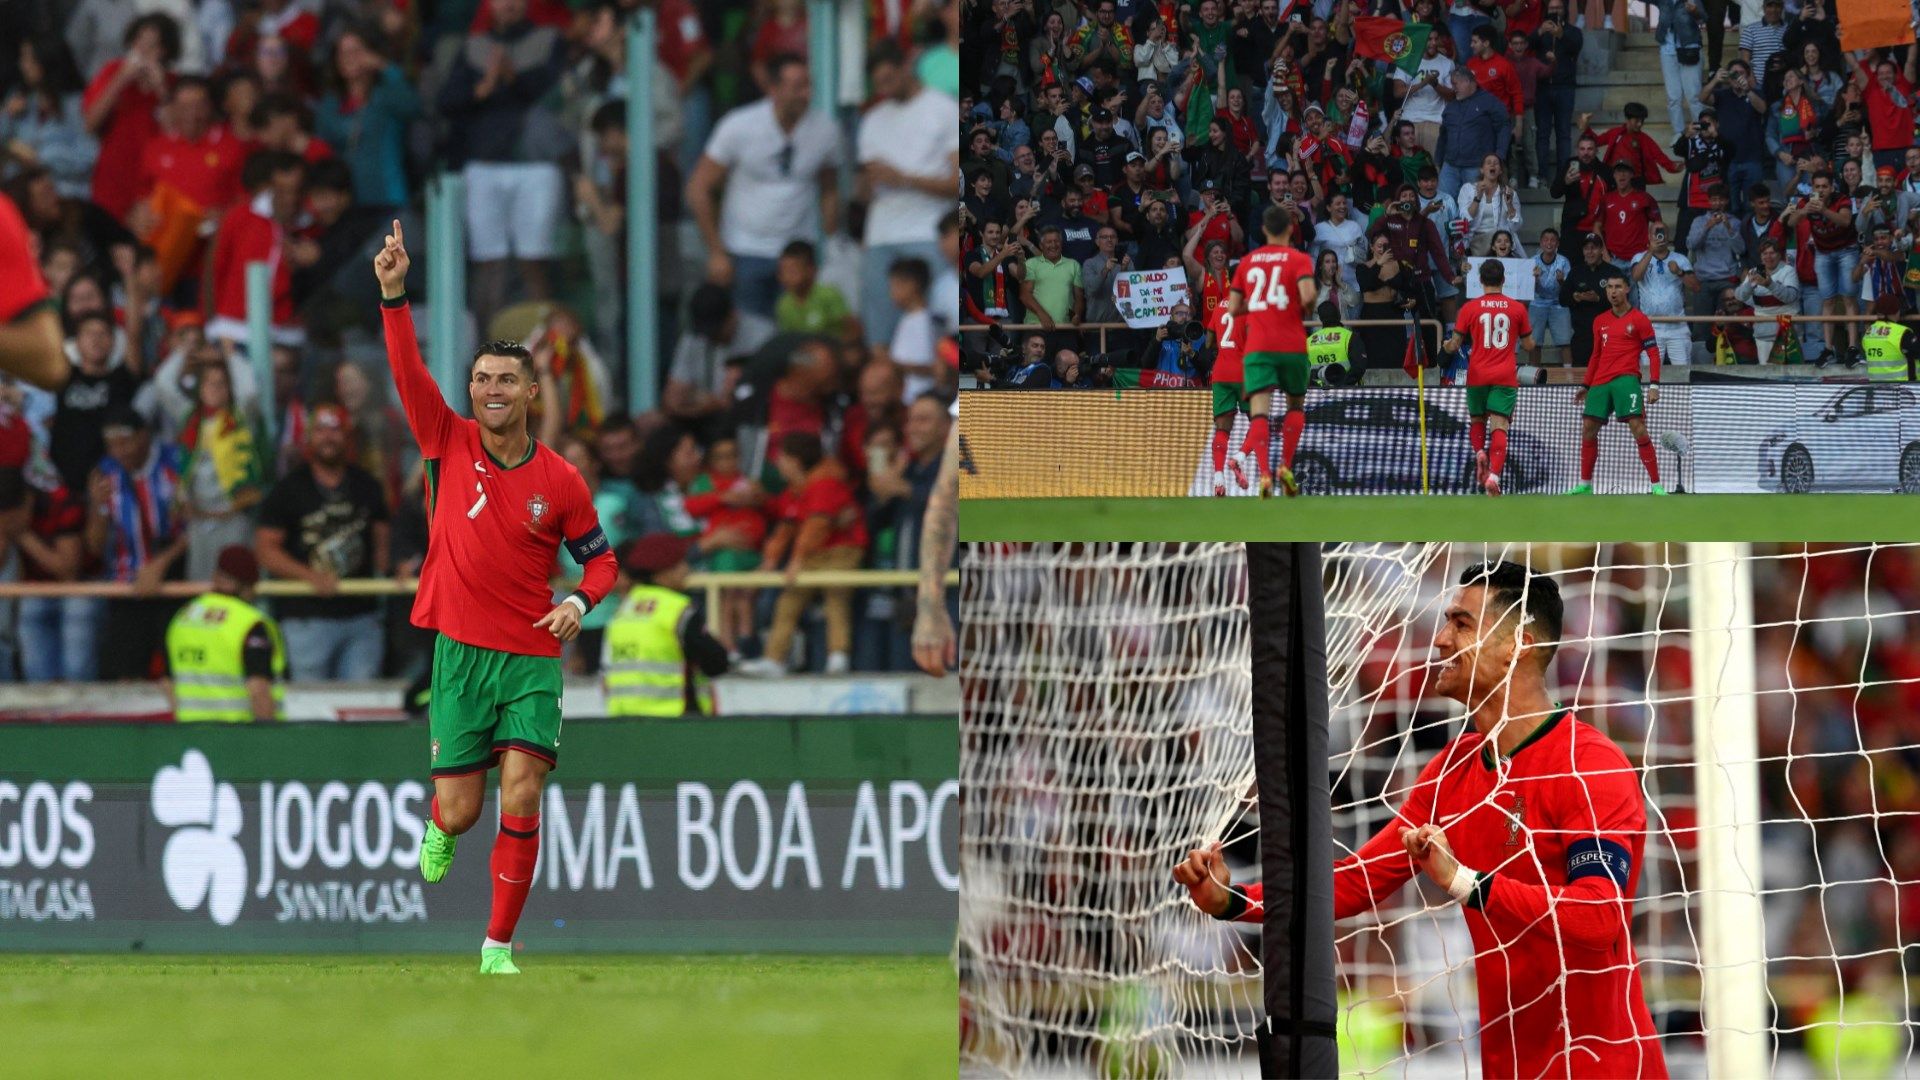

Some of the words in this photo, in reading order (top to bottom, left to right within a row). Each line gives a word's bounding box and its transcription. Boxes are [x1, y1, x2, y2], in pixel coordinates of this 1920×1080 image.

[1619, 210, 1626, 224] 9
[1129, 272, 1168, 285] RONALDO
[1246, 266, 1290, 311] 24
[1480, 300, 1509, 308] R.NEVES
[1220, 312, 1236, 348] 2
[1479, 312, 1511, 350] 18
[1317, 353, 1337, 363] 063
[1629, 393, 1638, 408] 7
[256, 780, 426, 898] JOGOS
[677, 780, 823, 891] BOA
[1571, 853, 1613, 867] RESPECT
